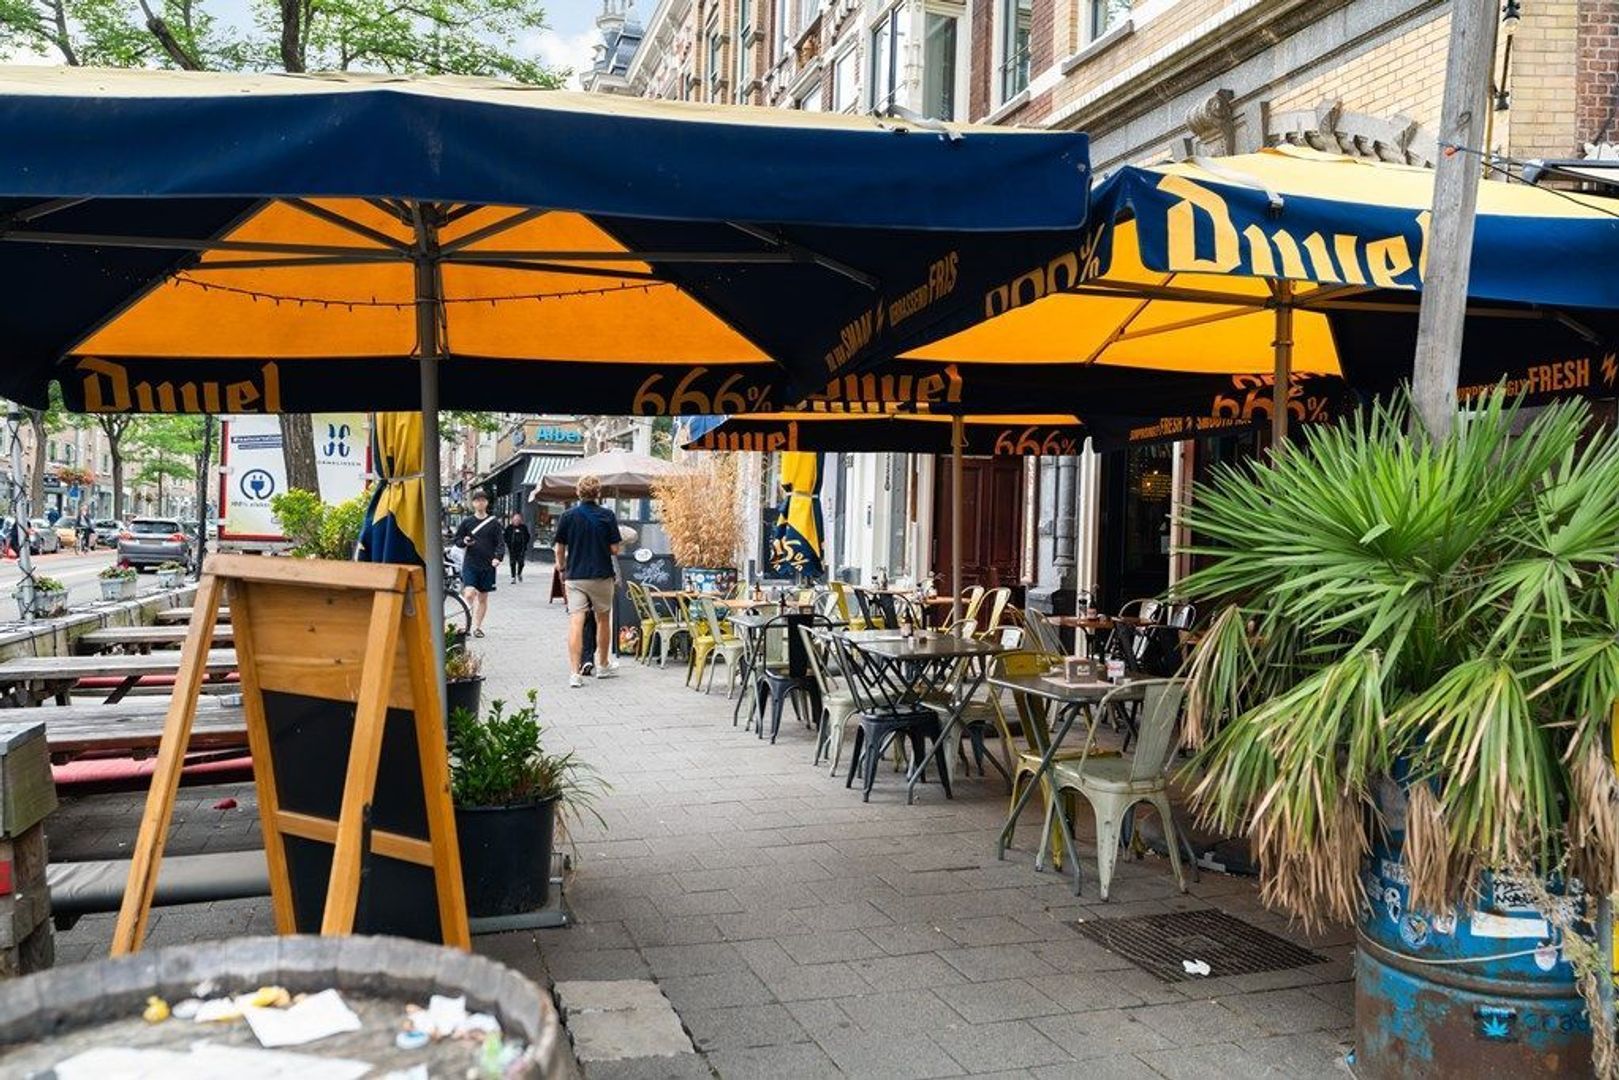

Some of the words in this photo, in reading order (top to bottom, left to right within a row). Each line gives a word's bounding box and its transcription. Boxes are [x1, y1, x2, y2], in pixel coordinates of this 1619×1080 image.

[929, 251, 957, 303] FRIS
[76, 356, 282, 413] Duvel
[1528, 358, 1590, 394] FRESH
